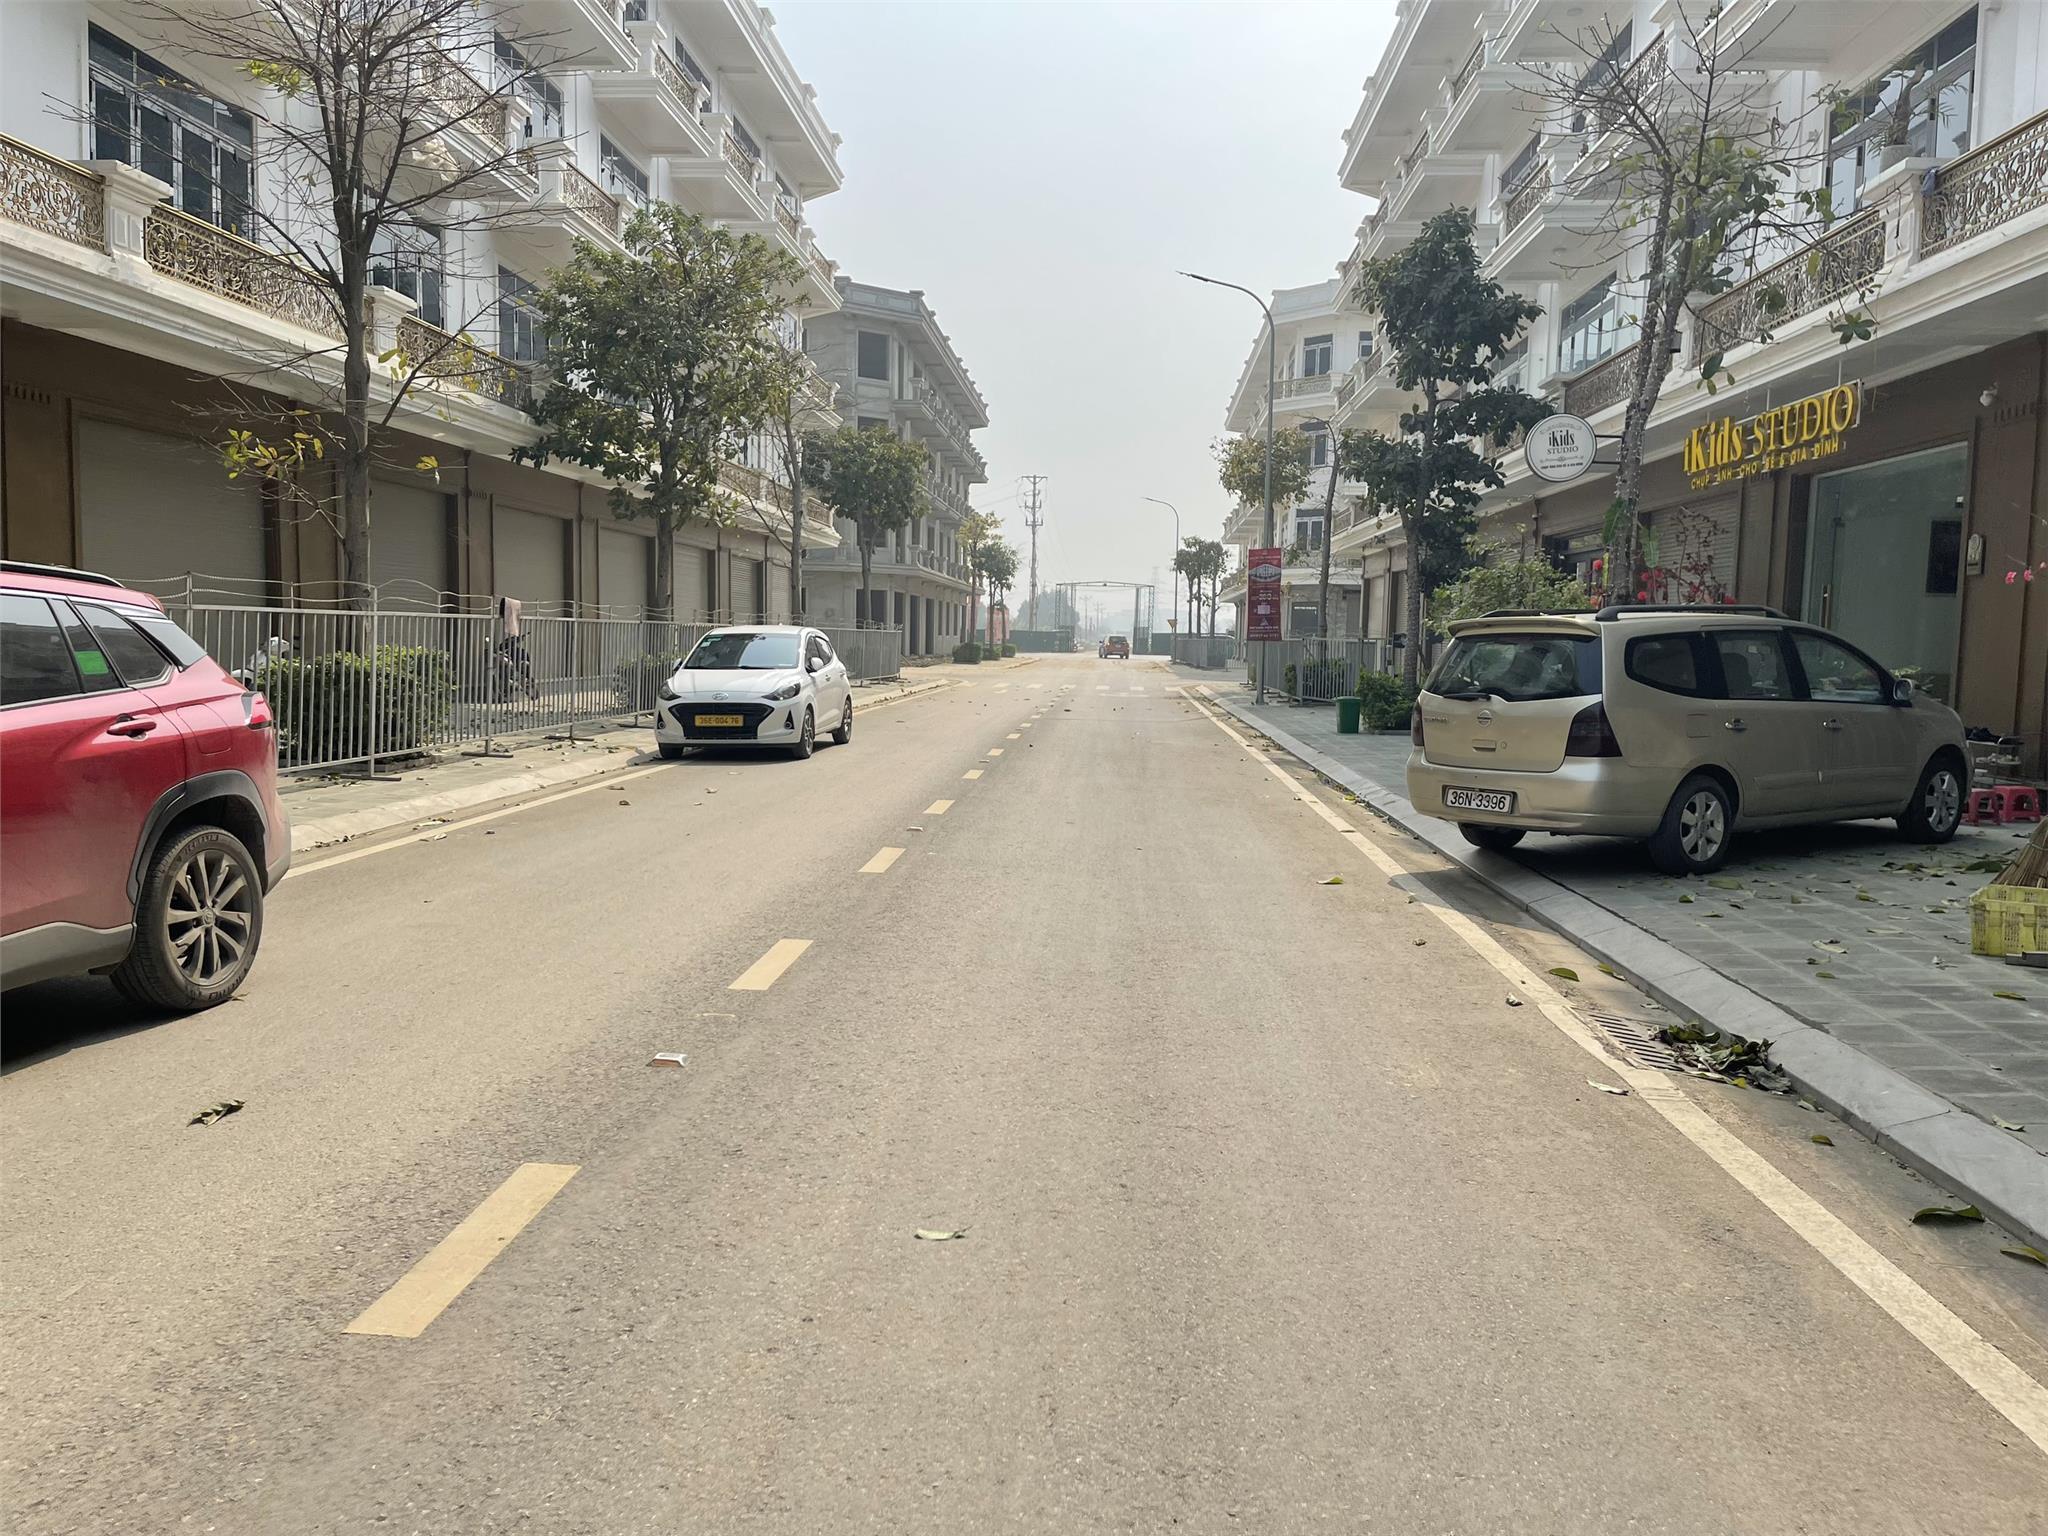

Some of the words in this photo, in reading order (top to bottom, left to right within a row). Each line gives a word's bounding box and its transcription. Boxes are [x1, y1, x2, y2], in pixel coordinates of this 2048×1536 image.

[1548, 429, 1575, 447] iKids
[1683, 416, 1743, 473] iKids
[1753, 385, 1854, 456] STUDIO
[1547, 445, 1579, 455] STUDIO
[1740, 461, 1757, 477] CHO
[1790, 446, 1807, 465] GIA
[1450, 790, 1507, 810] 36N-3396
